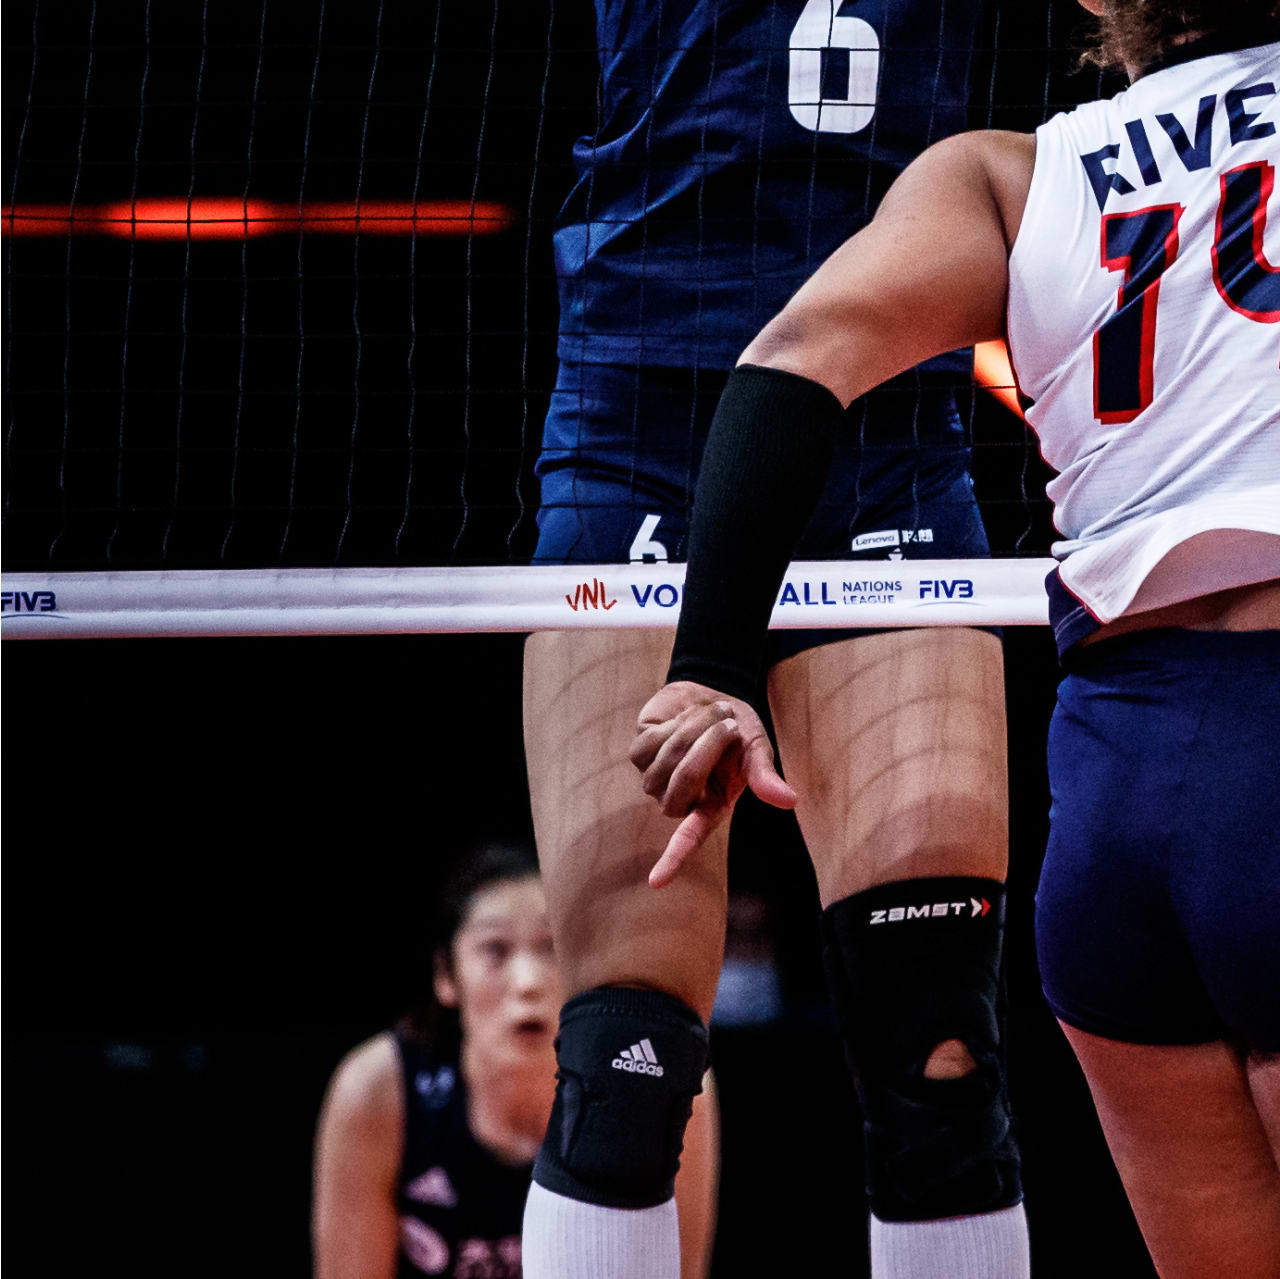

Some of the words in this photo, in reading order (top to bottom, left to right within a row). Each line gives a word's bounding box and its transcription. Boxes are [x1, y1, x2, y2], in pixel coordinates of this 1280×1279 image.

[565, 578, 618, 611] VNL
[842, 580, 903, 593] NATIONS
[919, 579, 974, 600] FIVB
[843, 595, 895, 605] LEAGUE
[612, 1056, 664, 1078] adidas
